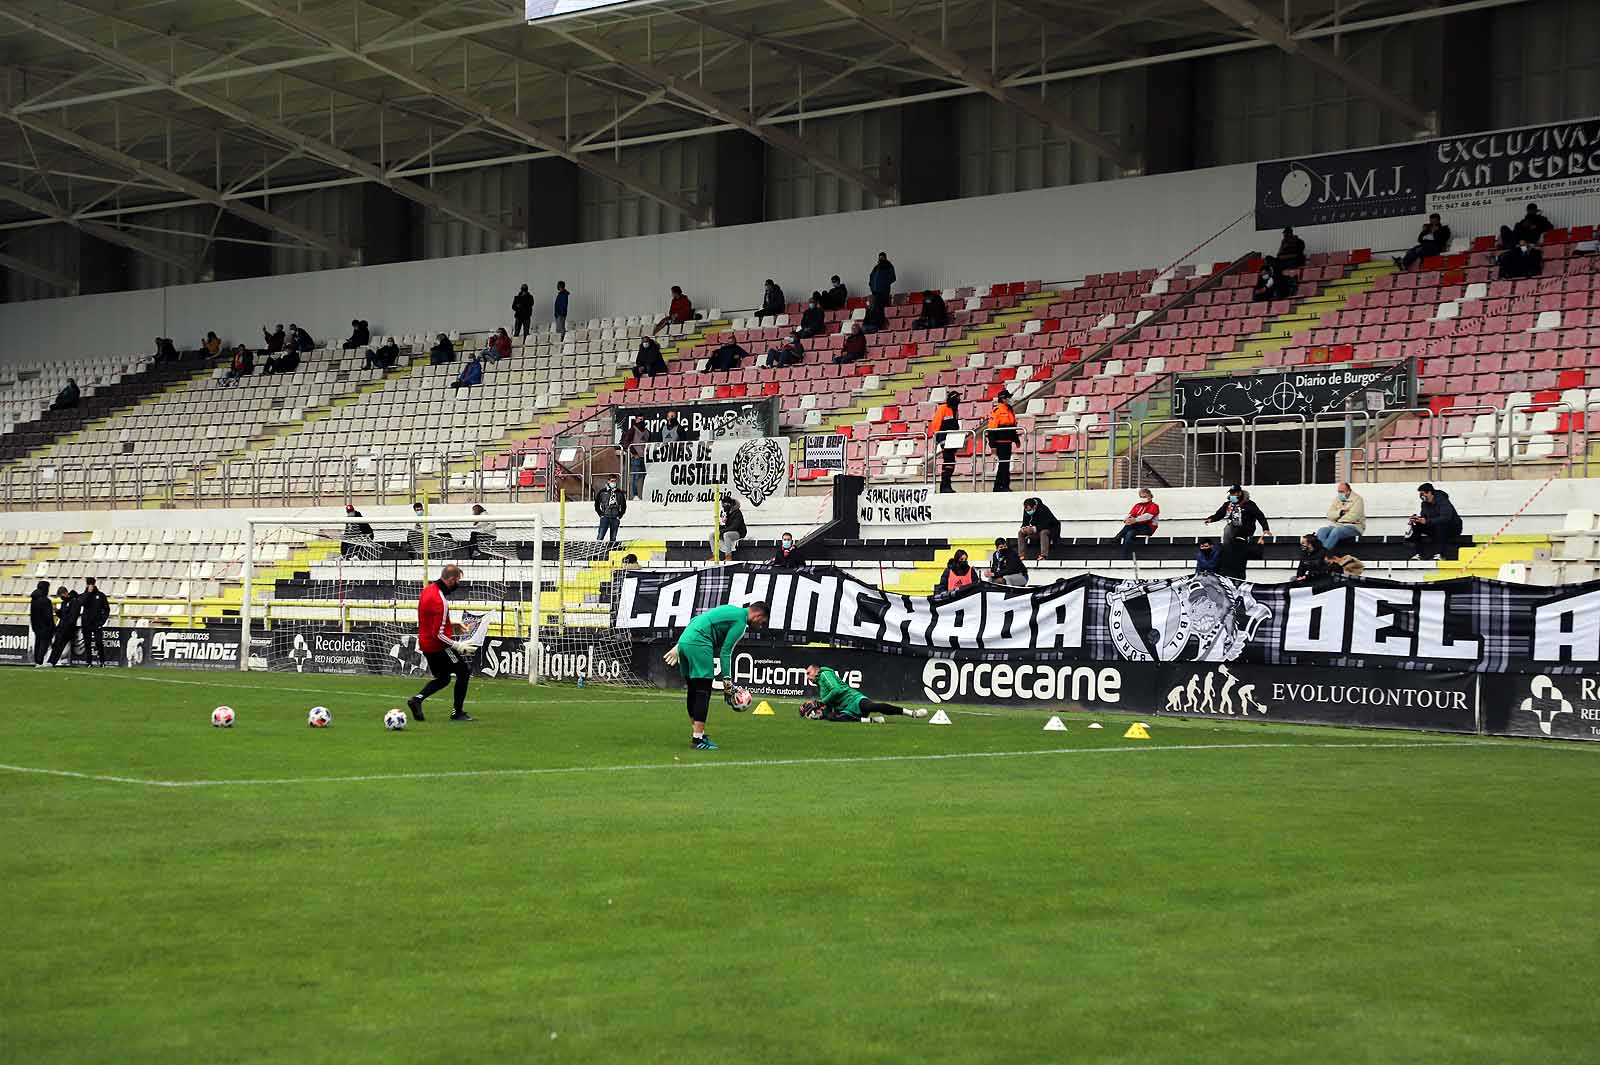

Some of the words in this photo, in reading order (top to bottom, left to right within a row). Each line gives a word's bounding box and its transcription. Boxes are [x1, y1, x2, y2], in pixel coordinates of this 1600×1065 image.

[1436, 163, 1491, 190] SAN
[1508, 150, 1600, 182] PEDRO
[1317, 165, 1413, 204] J.M.J.
[1296, 373, 1327, 387] Diario
[1329, 372, 1342, 384] de
[645, 441, 694, 464] LEONAS
[695, 441, 712, 462] DE
[670, 463, 728, 486] CASTILLA
[652, 489, 664, 502] Un
[664, 488, 695, 507] fondo
[866, 487, 929, 505] SANCIONADO
[860, 506, 873, 522] NO
[878, 507, 890, 522] TE
[616, 573, 698, 628] LA
[729, 572, 1086, 650] HINCHADA
[1284, 585, 1480, 660] DEL
[315, 635, 366, 652] Recoletas
[481, 640, 523, 678] San
[734, 652, 863, 689] Automve
[766, 686, 776, 695] the
[776, 687, 805, 697] customer
